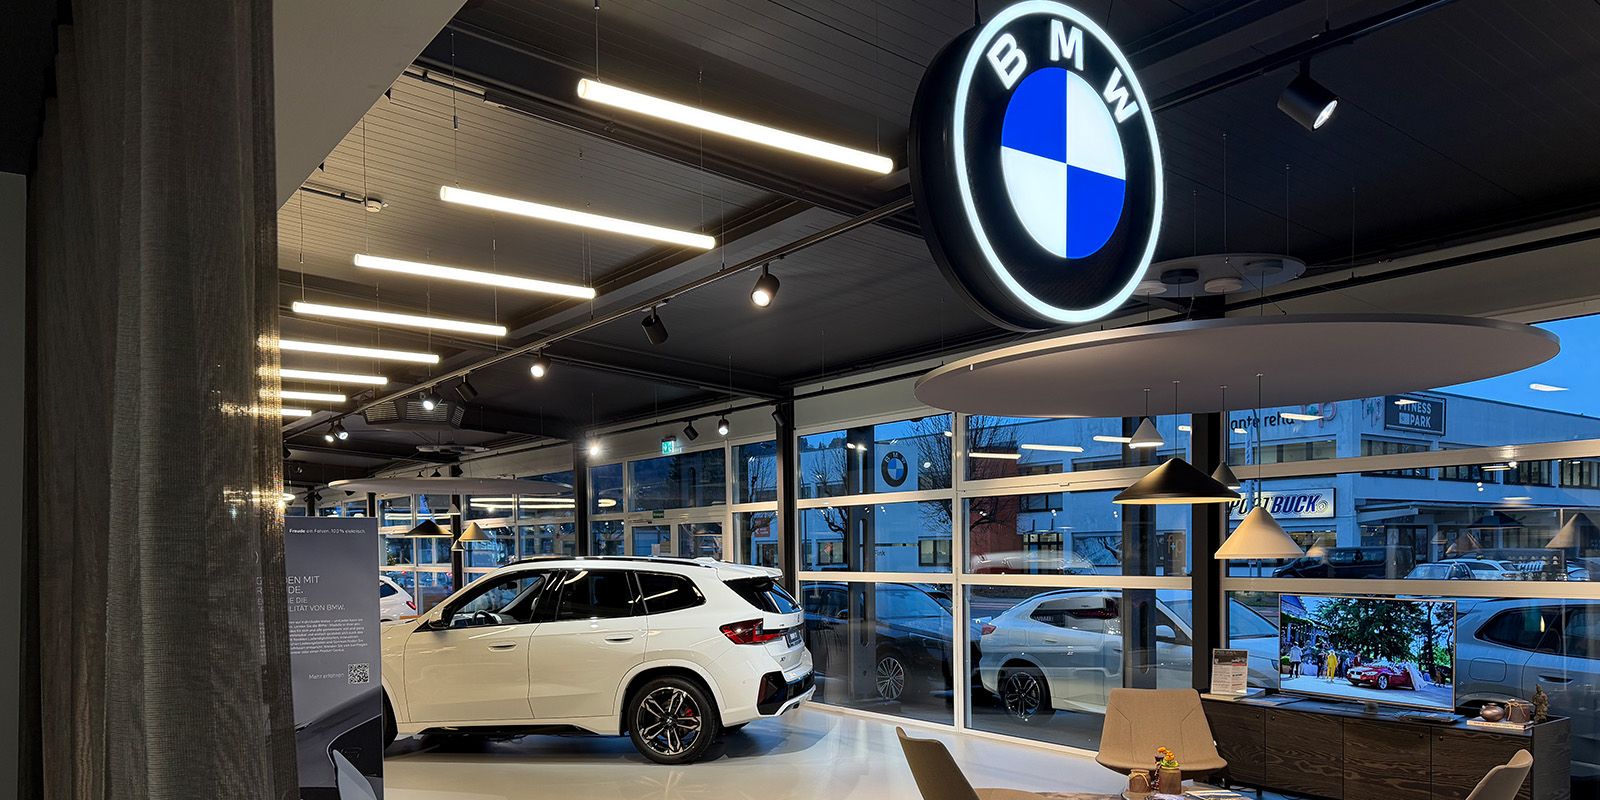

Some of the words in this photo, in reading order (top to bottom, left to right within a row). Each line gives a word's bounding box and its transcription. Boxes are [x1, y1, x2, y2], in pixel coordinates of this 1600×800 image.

[986, 18, 1140, 124] BMW
[1410, 414, 1431, 428] PARK
[303, 575, 320, 584] MIT
[288, 586, 304, 595] DE.
[296, 596, 308, 604] DIE
[310, 604, 325, 612] VON
